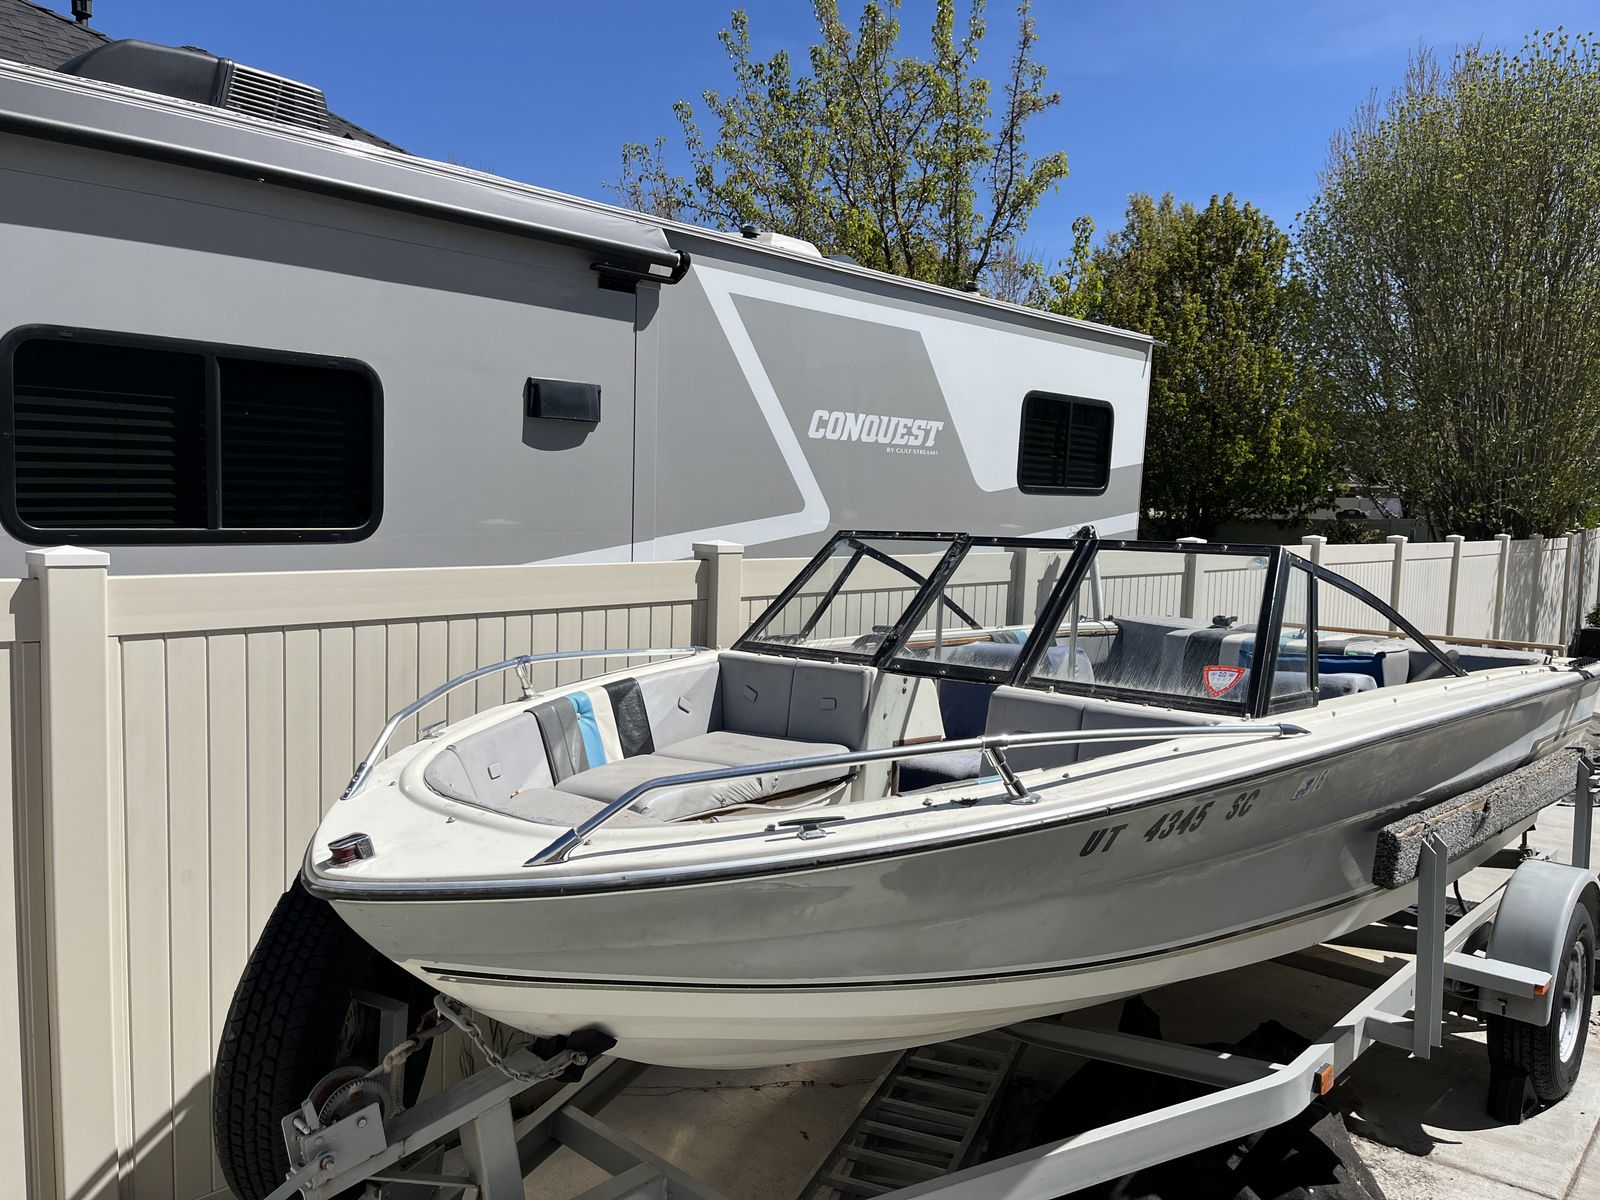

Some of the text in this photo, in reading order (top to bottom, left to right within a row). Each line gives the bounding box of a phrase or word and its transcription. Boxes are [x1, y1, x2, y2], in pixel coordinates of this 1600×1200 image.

[808, 409, 944, 447] CONQUEST
[896, 447, 912, 455] GULF
[1079, 789, 1261, 857] UT 4345 SC
